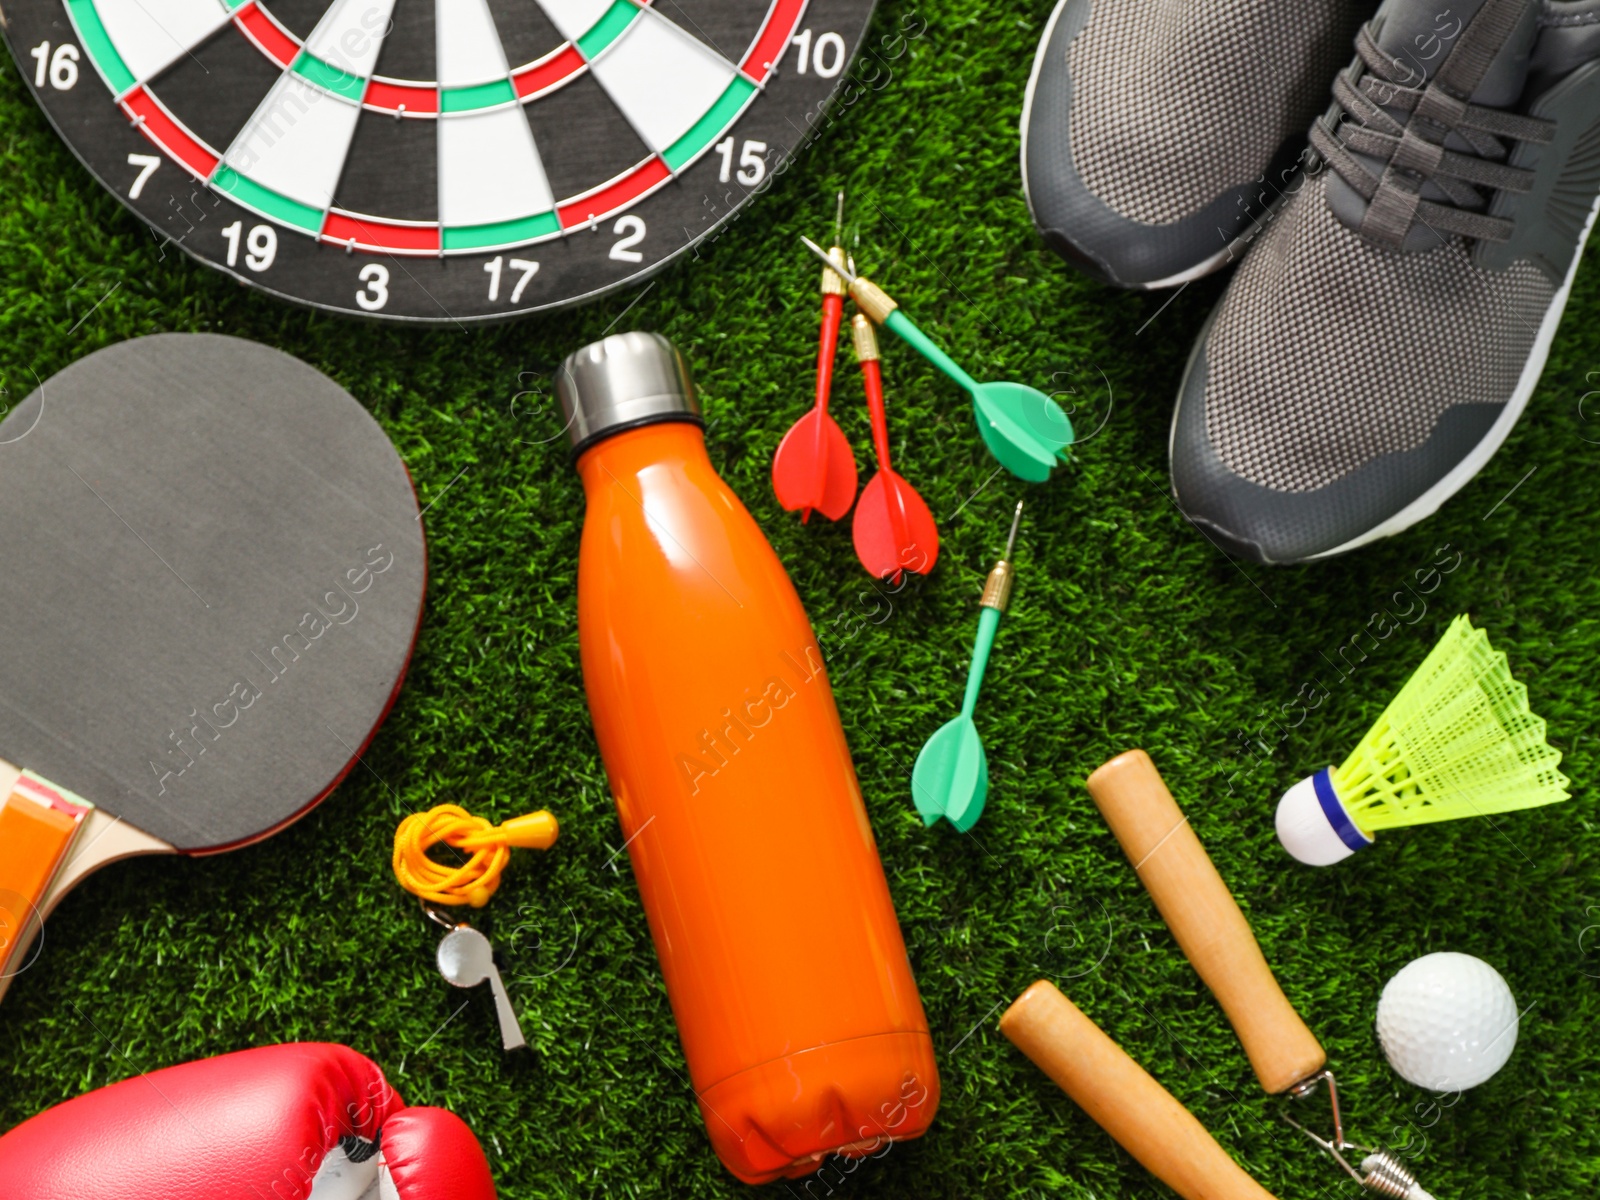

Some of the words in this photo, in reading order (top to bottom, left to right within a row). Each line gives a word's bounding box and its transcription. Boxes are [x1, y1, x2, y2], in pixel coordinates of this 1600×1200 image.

[31, 40, 80, 91] 16
[792, 29, 846, 79] 10
[127, 153, 161, 199] 7
[715, 136, 768, 187] 15
[221, 221, 278, 272] 19
[608, 215, 647, 263] 2
[356, 264, 390, 311] 3
[483, 256, 540, 304] 17
